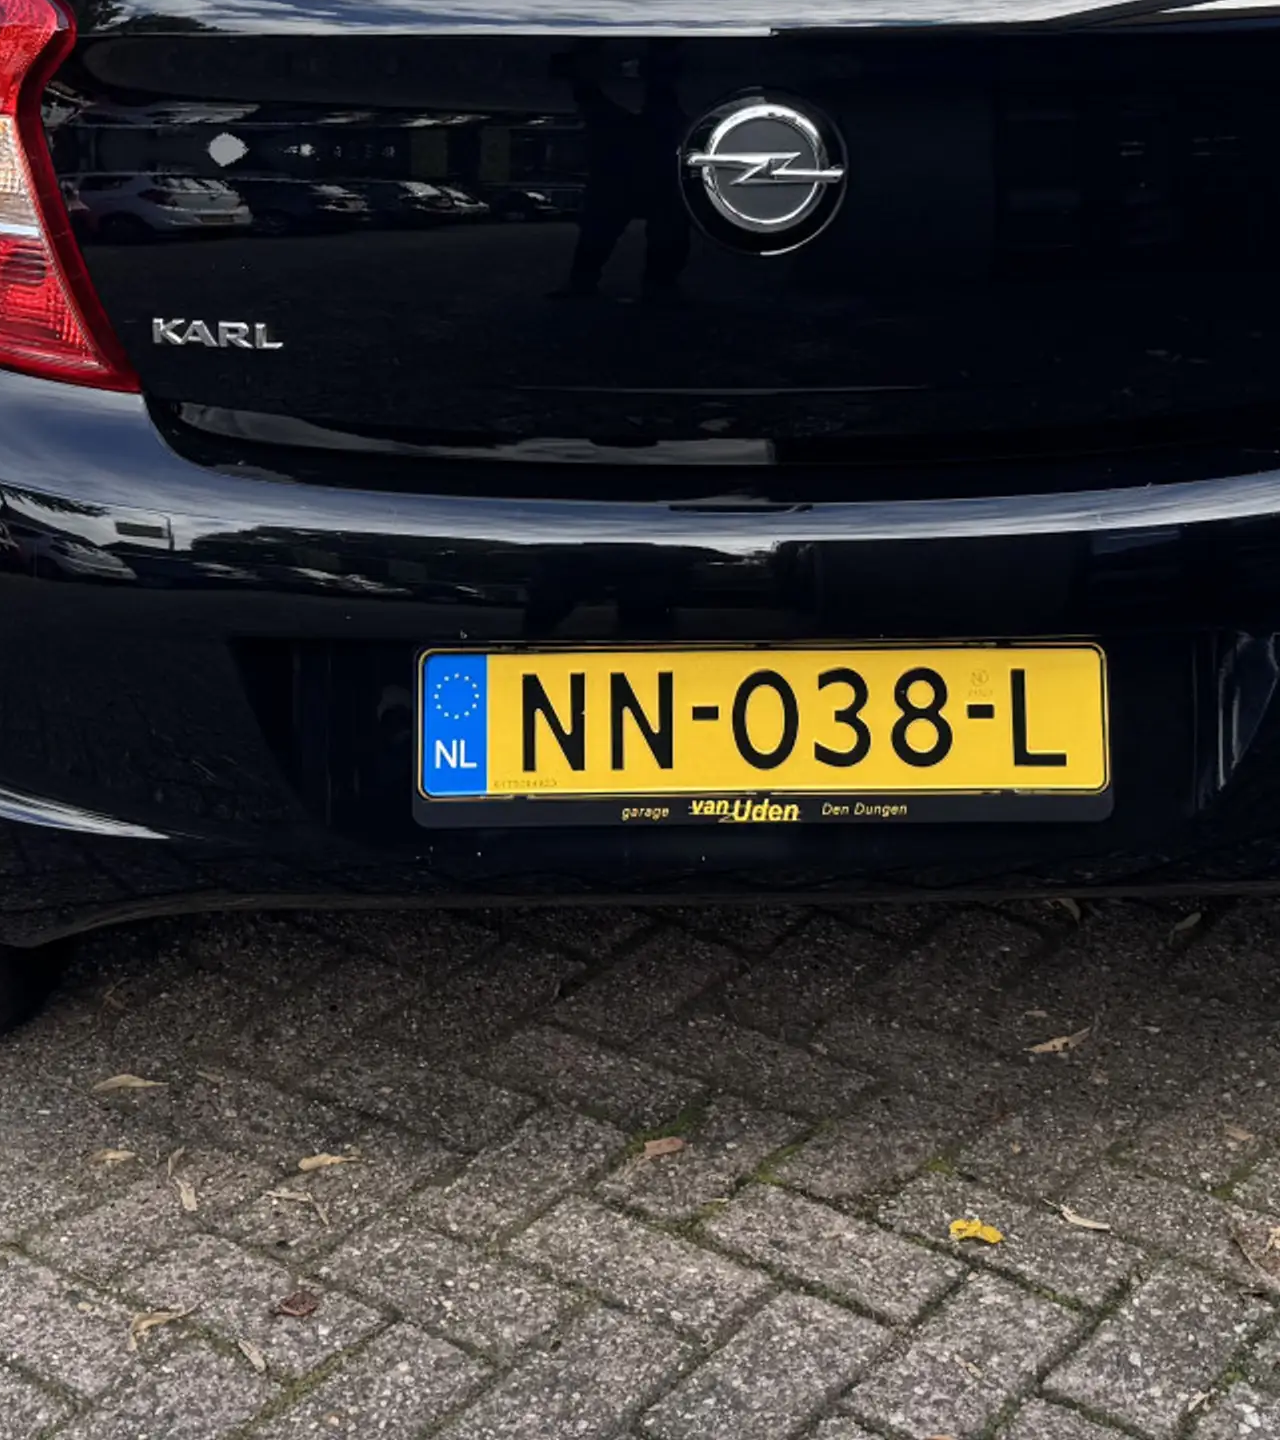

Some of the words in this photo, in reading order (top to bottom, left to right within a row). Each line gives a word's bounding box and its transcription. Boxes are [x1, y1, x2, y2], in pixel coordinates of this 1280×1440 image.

[152, 317, 284, 349] KARL
[434, 739, 477, 769] NL
[522, 667, 1067, 772] NN-038-L
[622, 807, 669, 821] garage
[691, 798, 729, 815] van
[732, 798, 800, 822] Uden
[822, 802, 849, 816] Den
[854, 802, 908, 818] Dungen
